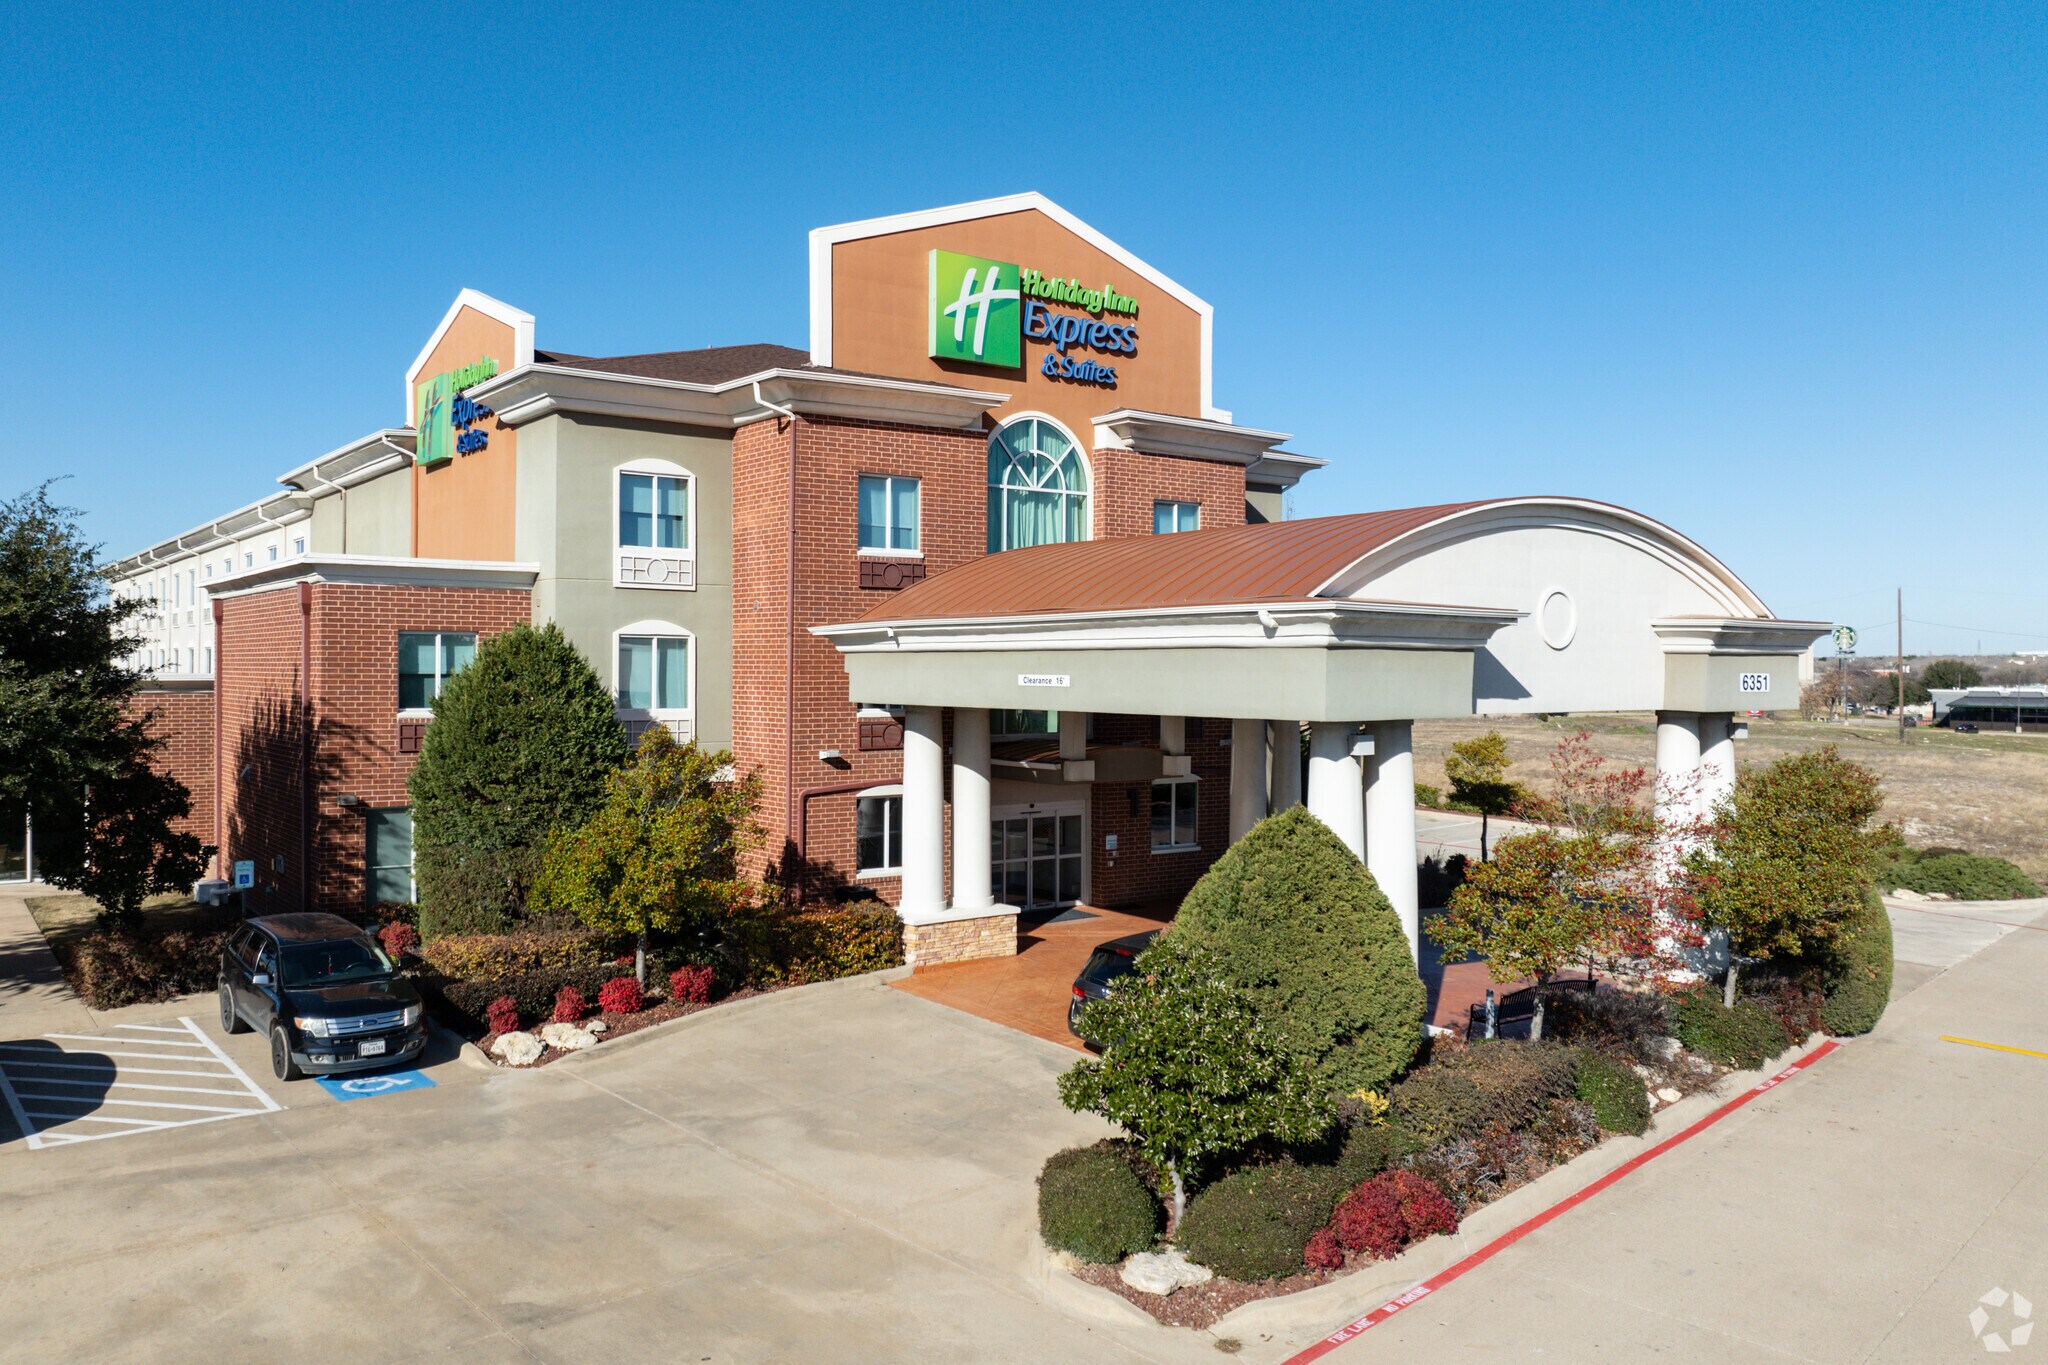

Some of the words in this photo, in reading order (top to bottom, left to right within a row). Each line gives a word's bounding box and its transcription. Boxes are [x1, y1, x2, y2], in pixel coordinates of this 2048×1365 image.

[1023, 300, 1137, 352] Express
[1023, 676, 1052, 685] Clearance
[1742, 674, 1768, 691] 6351
[1327, 1330, 1352, 1344] FIRE
[1347, 1318, 1375, 1333] LANE
[1382, 1303, 1399, 1313] NO
